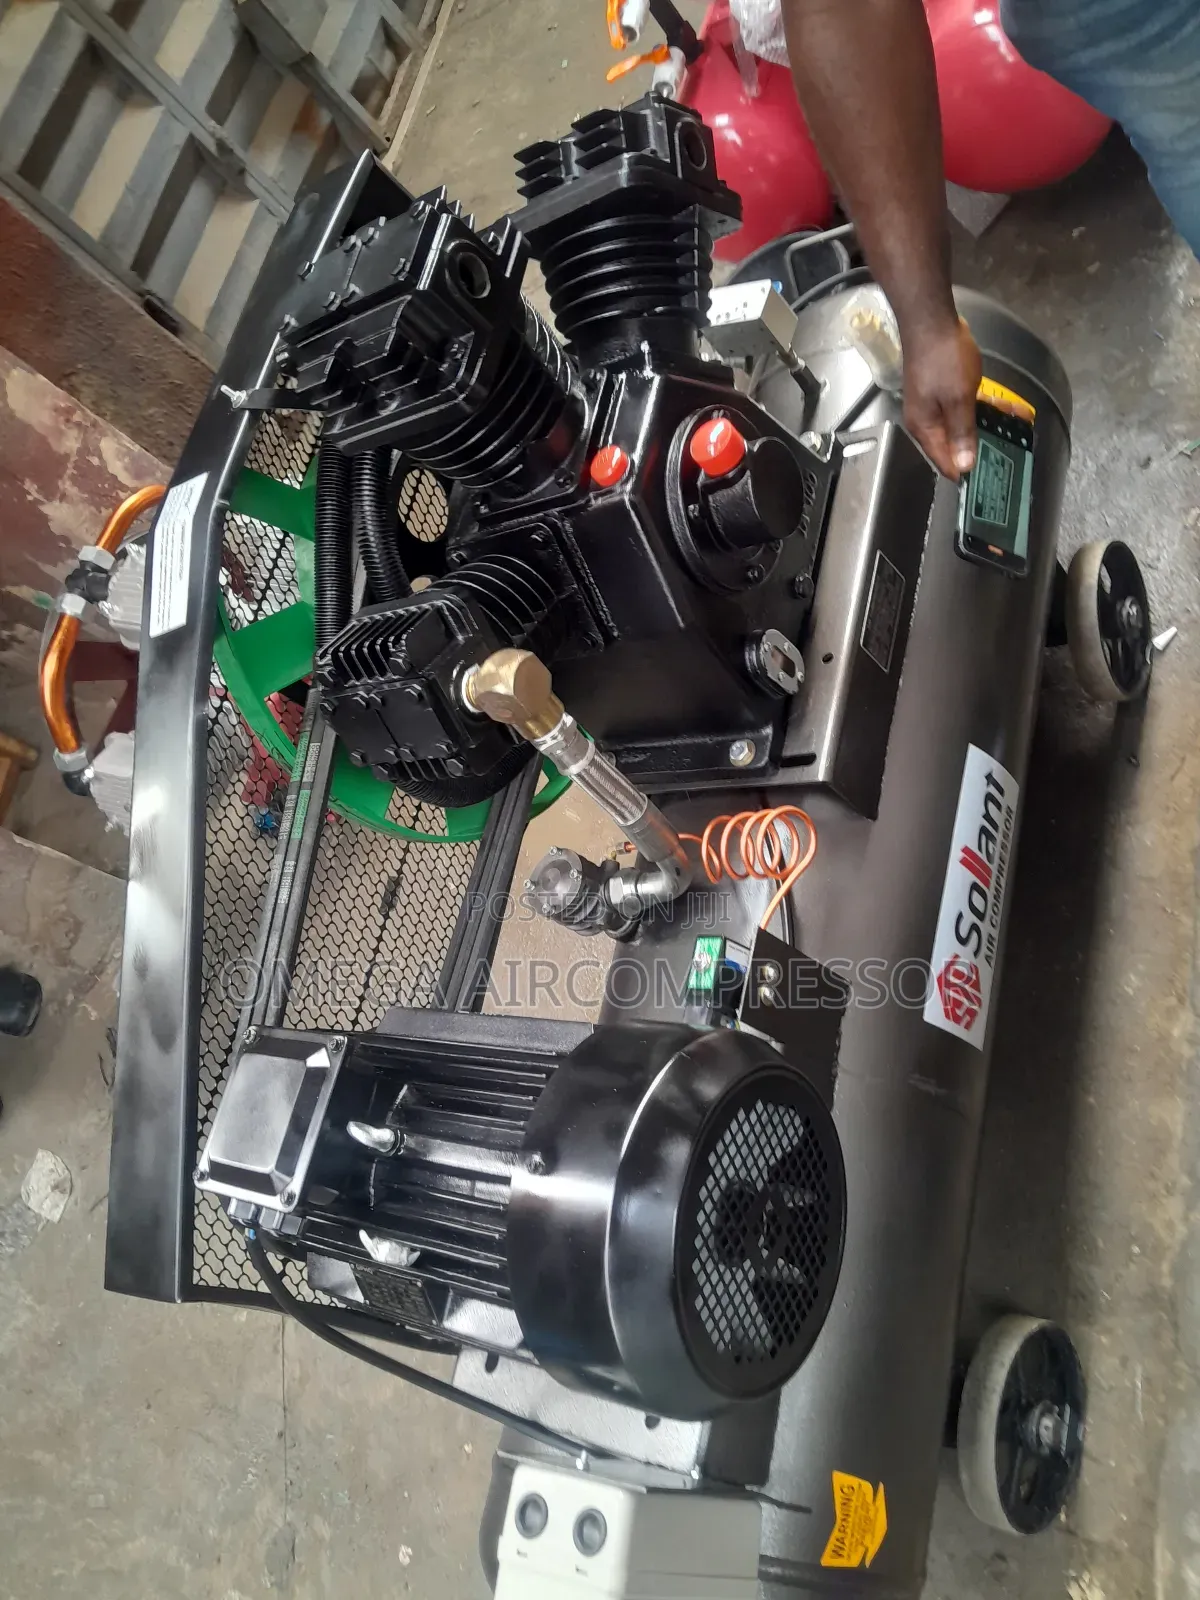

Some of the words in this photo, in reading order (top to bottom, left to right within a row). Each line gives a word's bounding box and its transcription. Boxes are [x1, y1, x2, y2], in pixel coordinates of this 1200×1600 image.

[954, 770, 1005, 959] Sollant
[990, 803, 1014, 930] COMPRESSOR
[984, 932, 997, 969] AIR
[830, 1484, 855, 1559] WARNING
